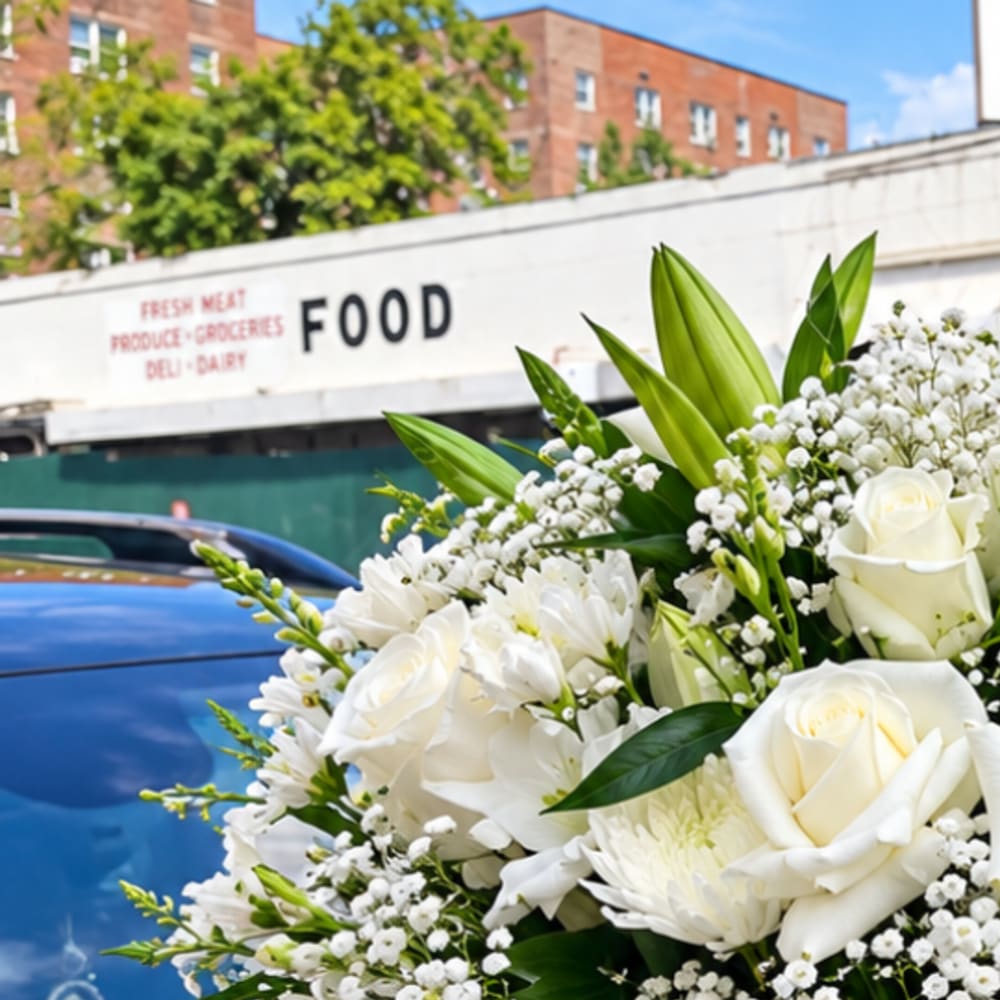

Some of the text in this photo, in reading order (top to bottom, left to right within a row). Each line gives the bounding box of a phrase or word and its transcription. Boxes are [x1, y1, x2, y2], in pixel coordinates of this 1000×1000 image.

[140, 288, 245, 320] FRESH MEAT
[301, 283, 453, 353] FOOD
[197, 351, 247, 376] DAIRY
